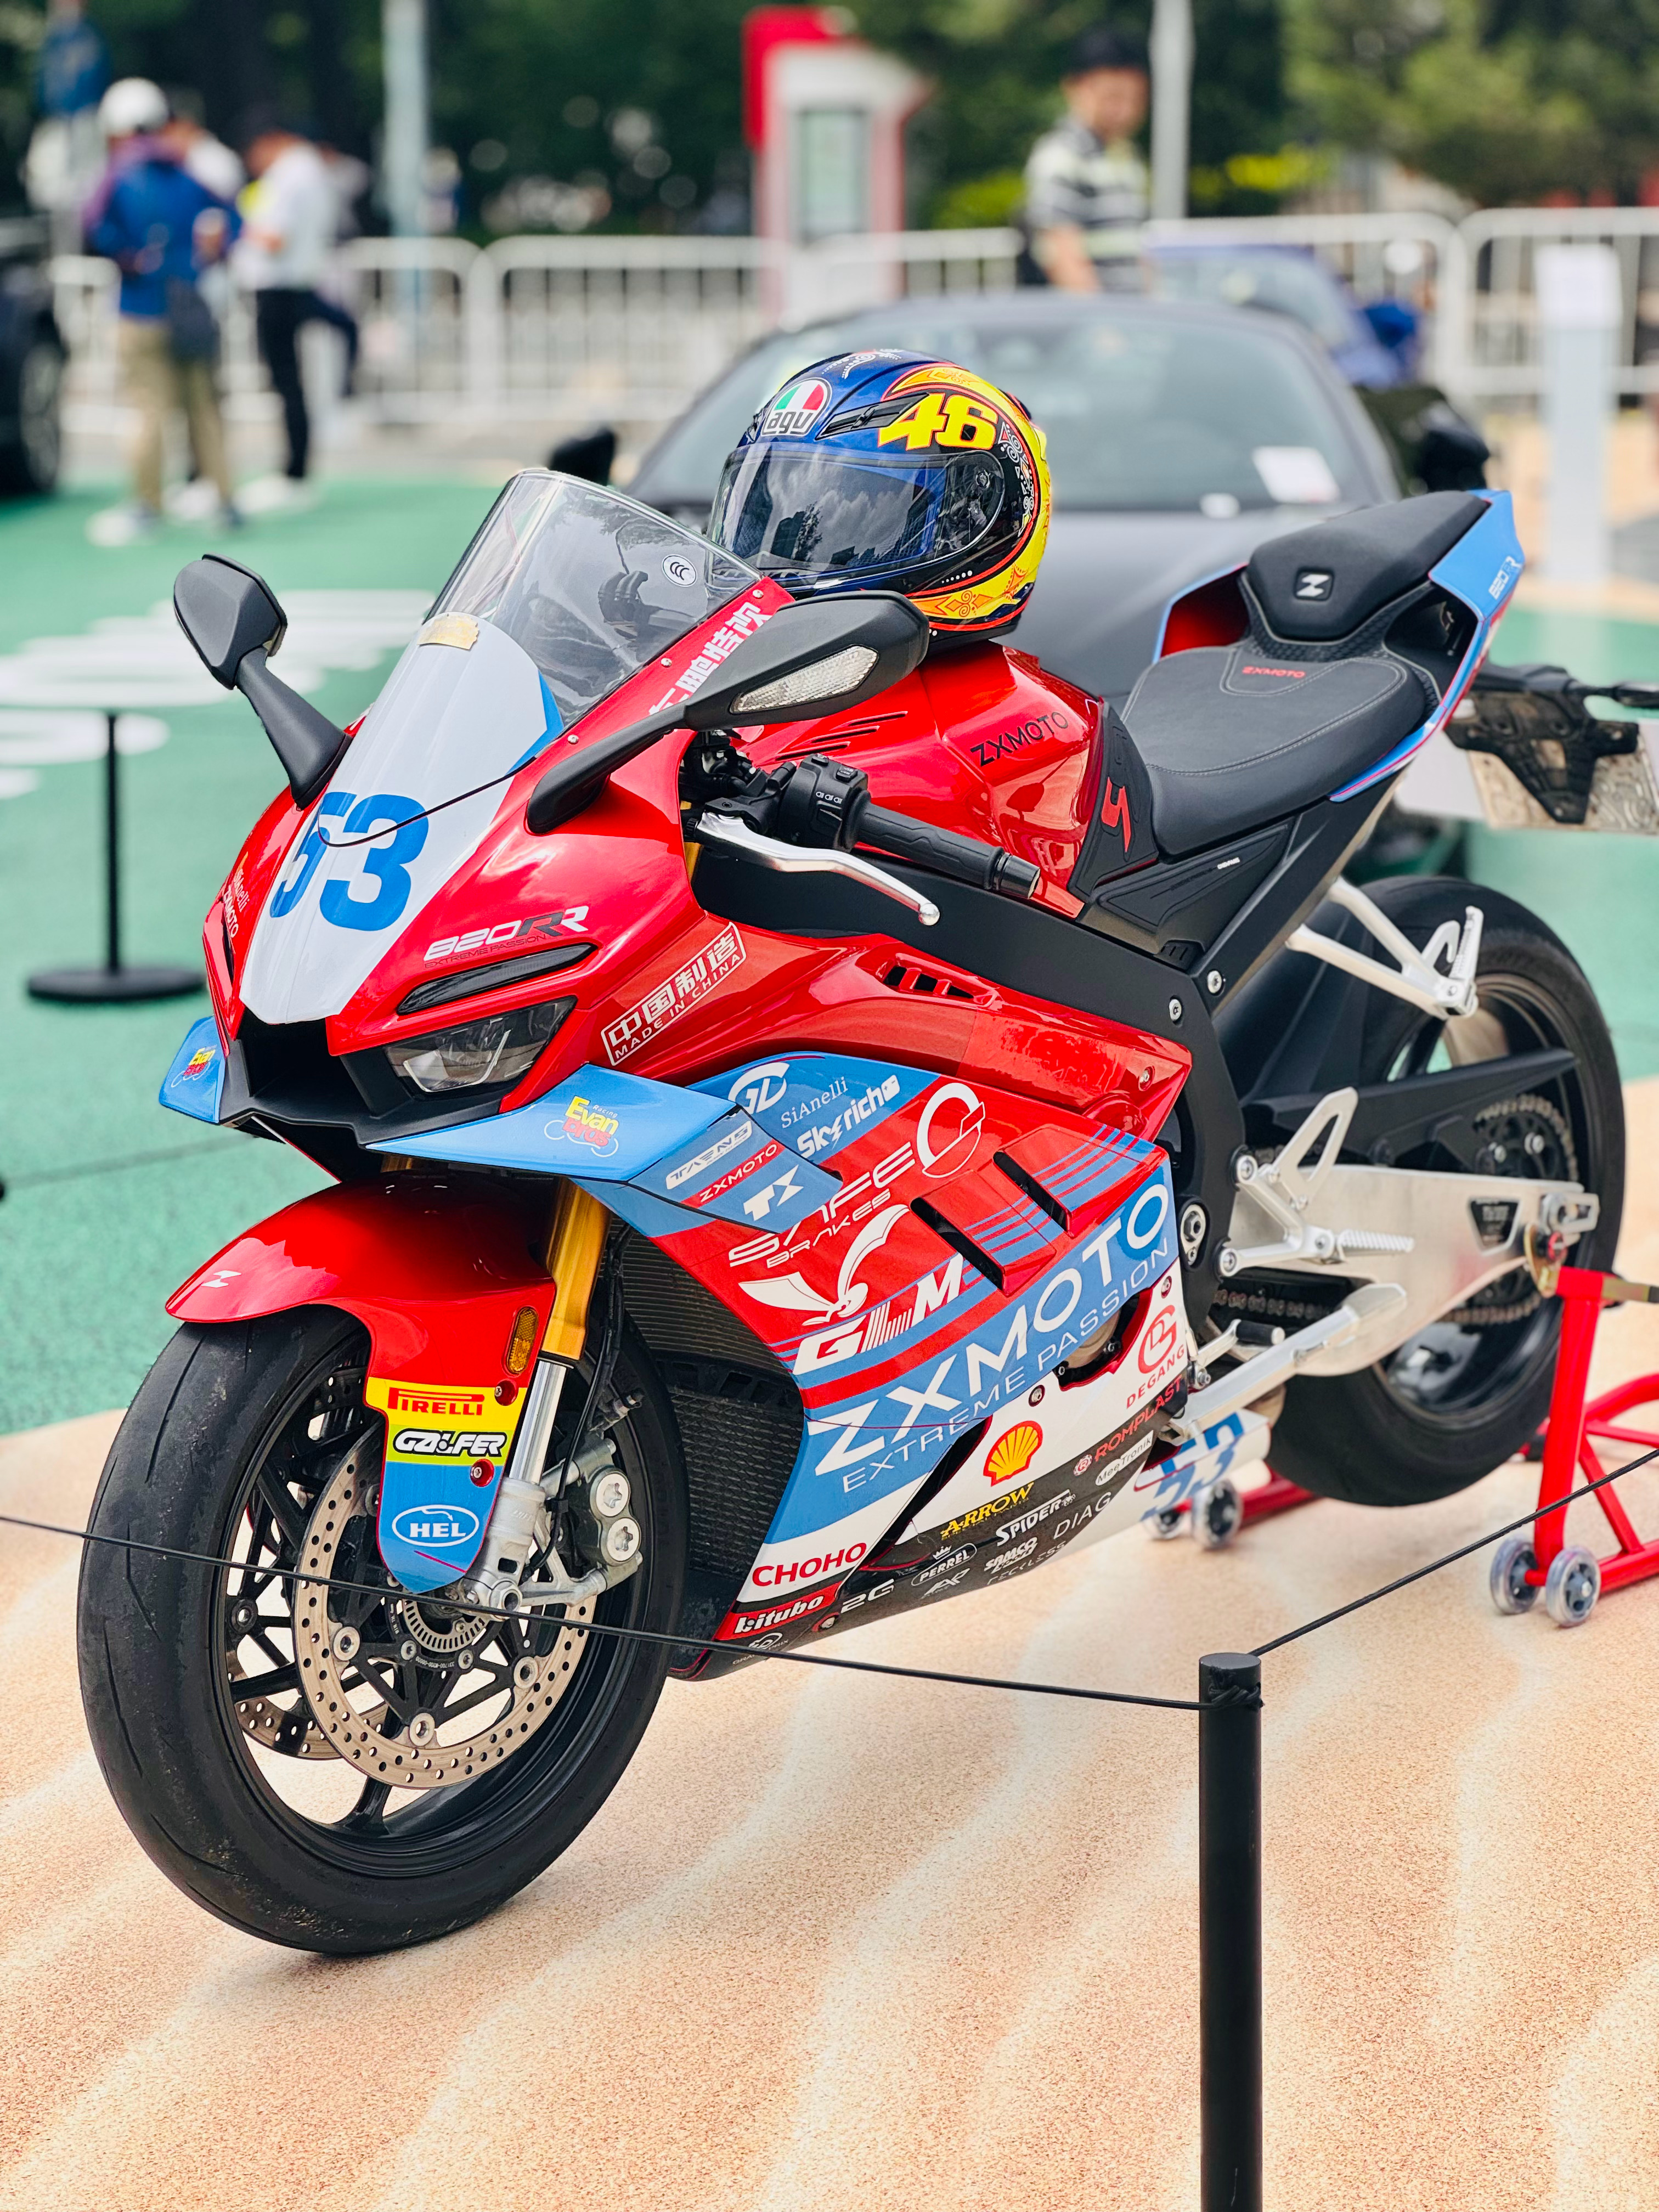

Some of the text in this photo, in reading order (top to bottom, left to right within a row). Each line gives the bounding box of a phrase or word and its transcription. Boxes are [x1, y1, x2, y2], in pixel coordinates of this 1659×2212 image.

[766, 411, 814, 434] agv
[878, 392, 998, 450] 46
[1242, 665, 1306, 678] ZXMOTO
[970, 711, 1069, 768] ZXMOTO
[269, 791, 429, 932] 53
[423, 905, 589, 961] 820RR
[424, 934, 546, 969] EXTREME PASSION
[608, 932, 738, 1048] 中国制造
[615, 954, 740, 1059] MADE IN CHINA
[565, 1095, 619, 1135] Evan
[592, 1104, 618, 1119] Racing
[781, 1076, 849, 1128] SiAnelli
[562, 1116, 612, 1147] bros
[699, 1143, 777, 1203] ZXMOTO
[767, 1188, 891, 1268] BRAKES
[808, 1183, 1169, 1476] ZXMOTO
[842, 1237, 1169, 1493] EXTREME PASSION
[1126, 1344, 1184, 1409] DEGANG
[387, 1387, 486, 1416] PIRELLI
[1095, 1374, 1183, 1462] ROMPLAST
[393, 1429, 507, 1457] GALFER
[410, 1522, 466, 1538] HEL
[940, 1482, 1035, 1536] ARROW
[995, 1489, 1070, 1547] SPIDER
[1054, 1491, 1112, 1540] DIAG
[752, 1542, 867, 1587] CHOHO
[919, 1549, 970, 1582] PERREL
[983, 1537, 1038, 1571] SAMCO
[733, 1594, 824, 1634] bitubo
